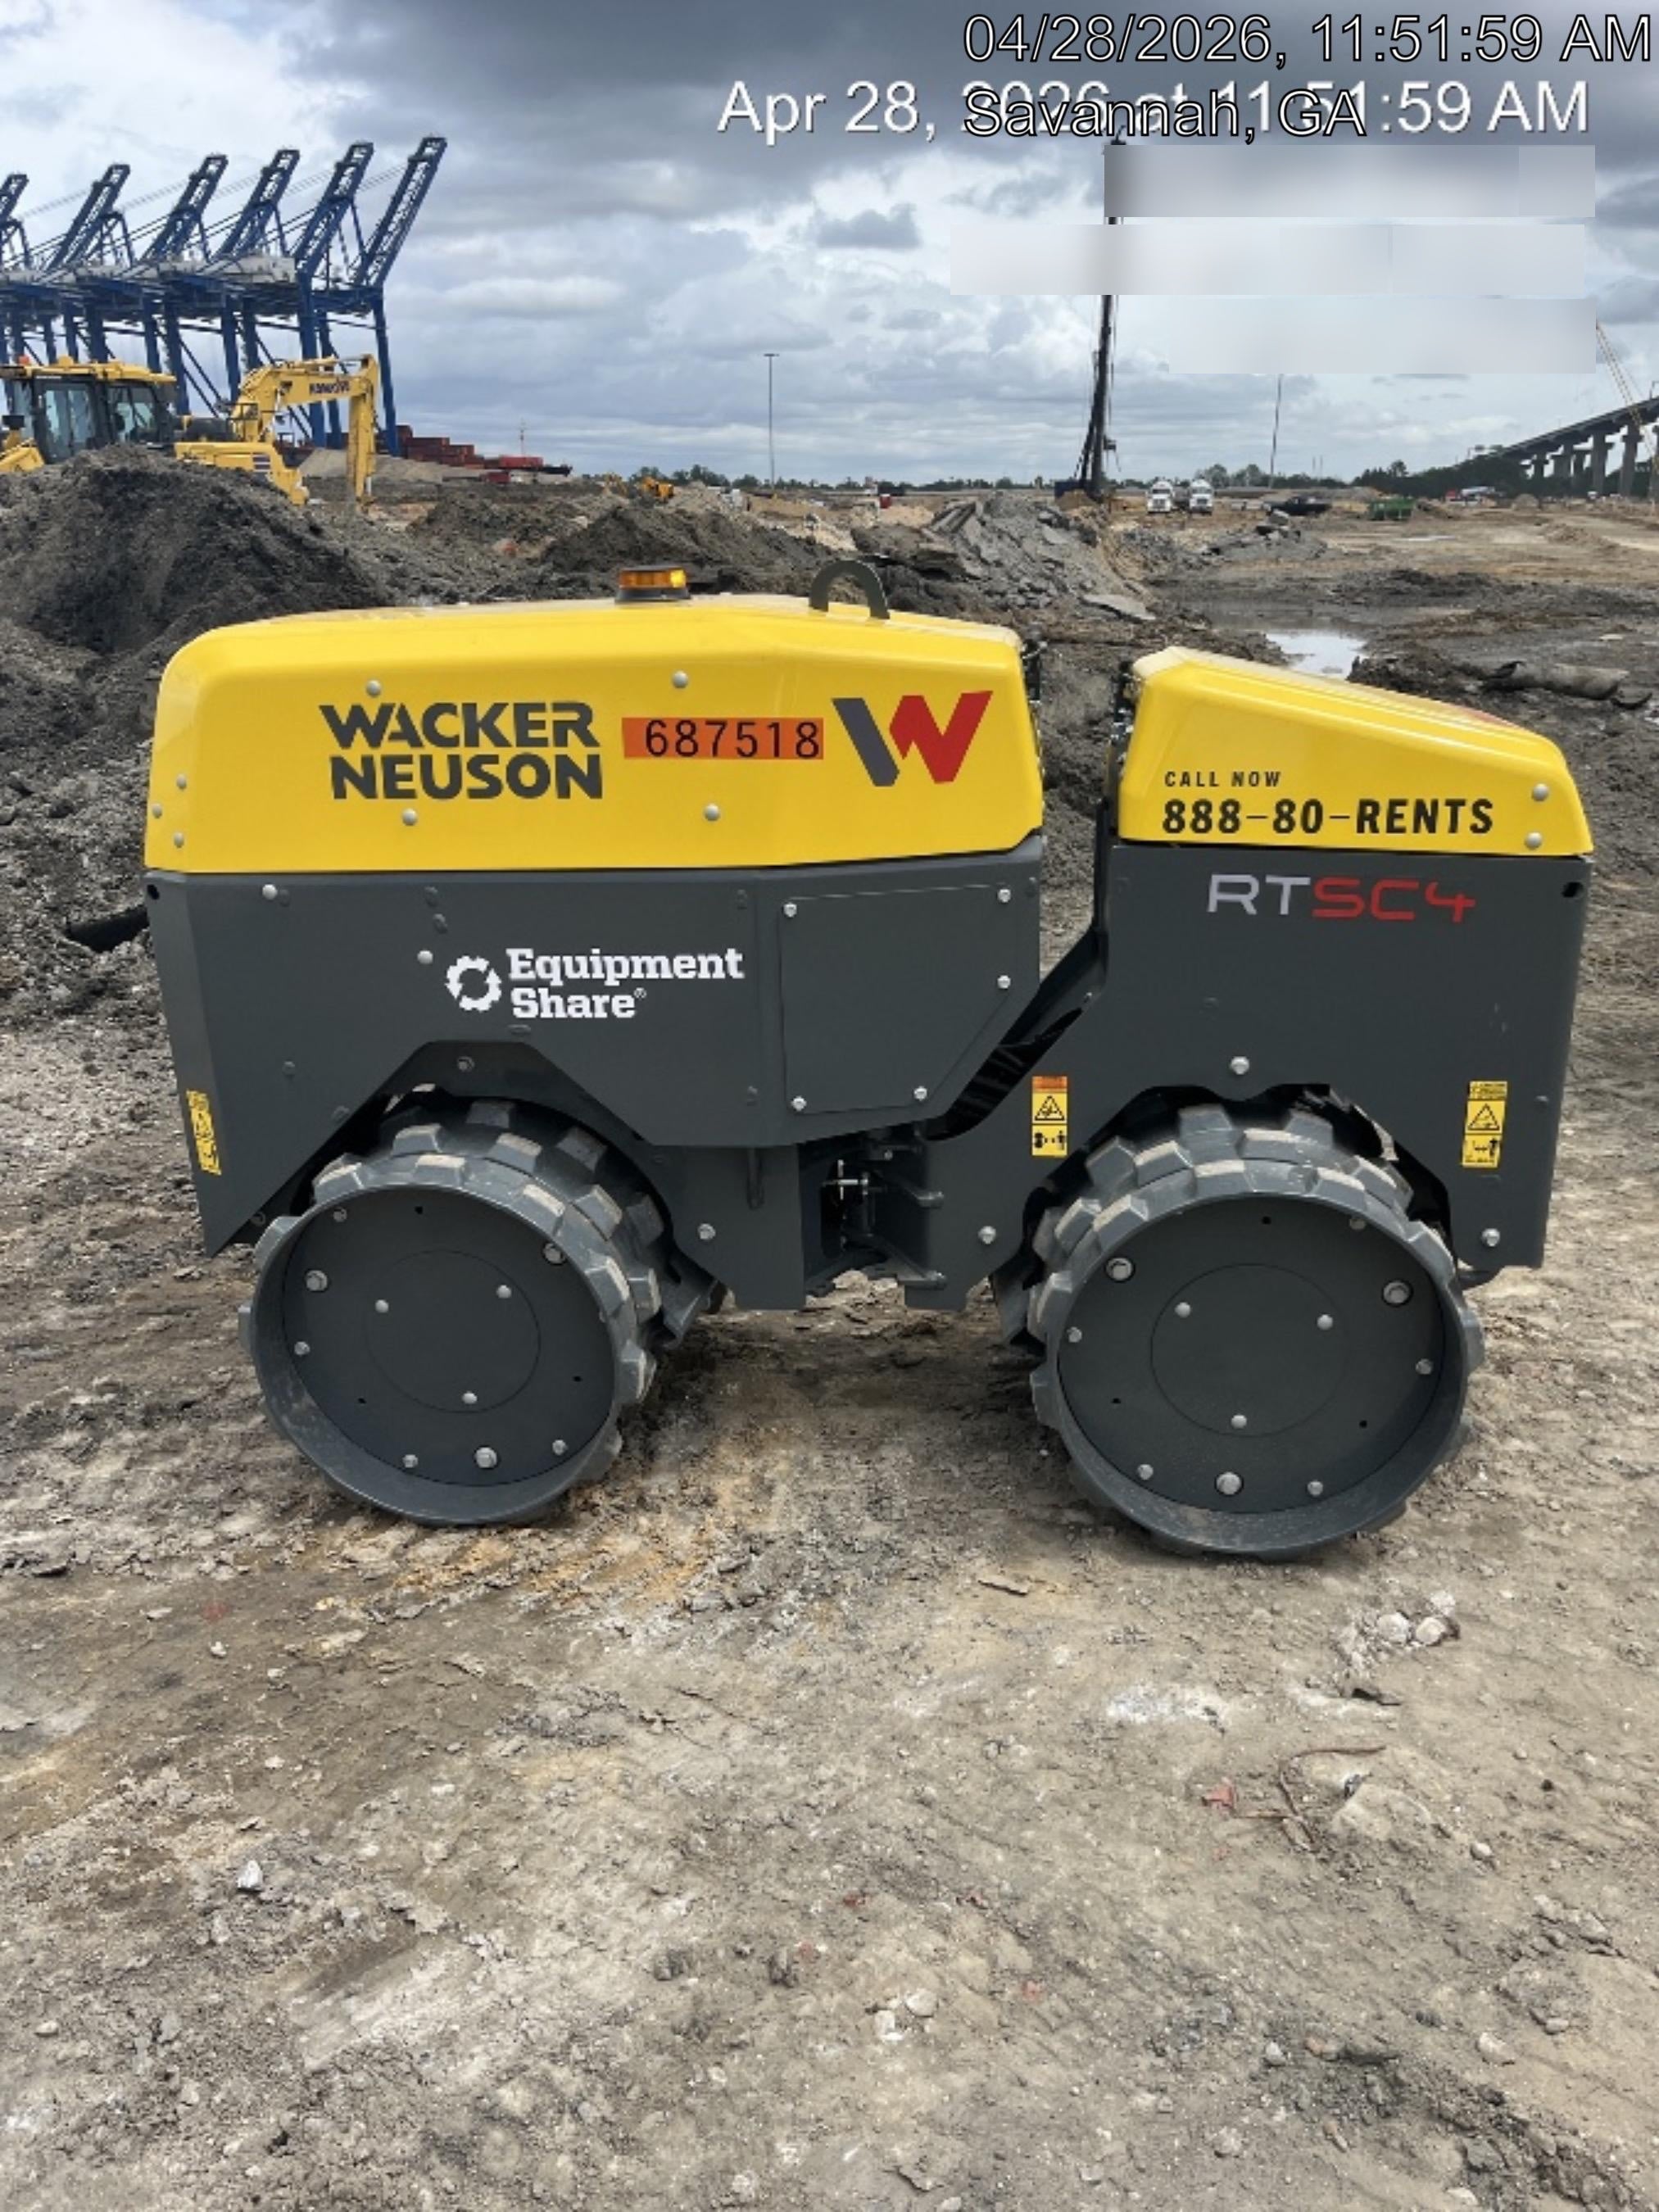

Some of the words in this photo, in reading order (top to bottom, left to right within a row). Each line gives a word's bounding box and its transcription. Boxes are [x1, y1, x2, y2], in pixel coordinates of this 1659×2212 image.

[319, 702, 601, 749] WACKER
[646, 719, 820, 759] 687518
[329, 752, 603, 800] NEUSON
[1164, 771, 1220, 787] CALL
[1231, 771, 1282, 787] NOW
[1162, 798, 1494, 834] 888-80-RENTS
[1207, 873, 1475, 923] RTSC4
[505, 948, 745, 986] Equipment
